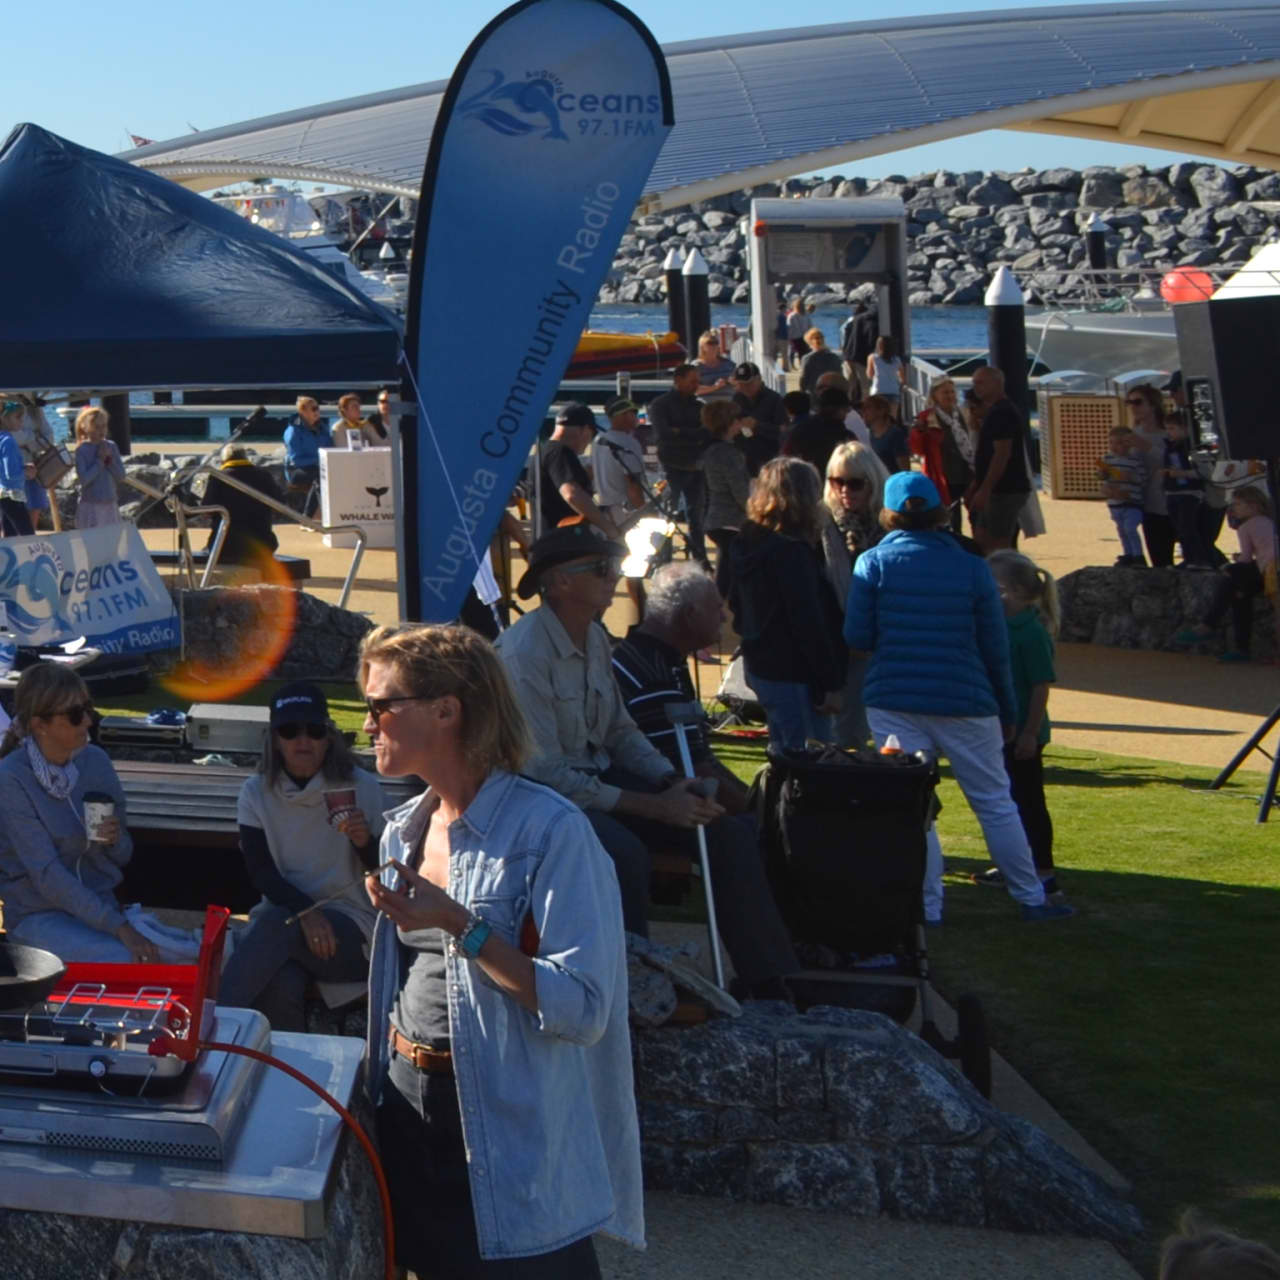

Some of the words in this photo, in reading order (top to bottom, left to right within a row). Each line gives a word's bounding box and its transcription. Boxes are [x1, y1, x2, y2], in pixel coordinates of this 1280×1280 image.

[423, 468, 499, 601] Augusta
[481, 279, 582, 459] Community
[557, 180, 620, 274] Radio
[339, 512, 379, 521] WHALE
[128, 624, 175, 649] Radio
